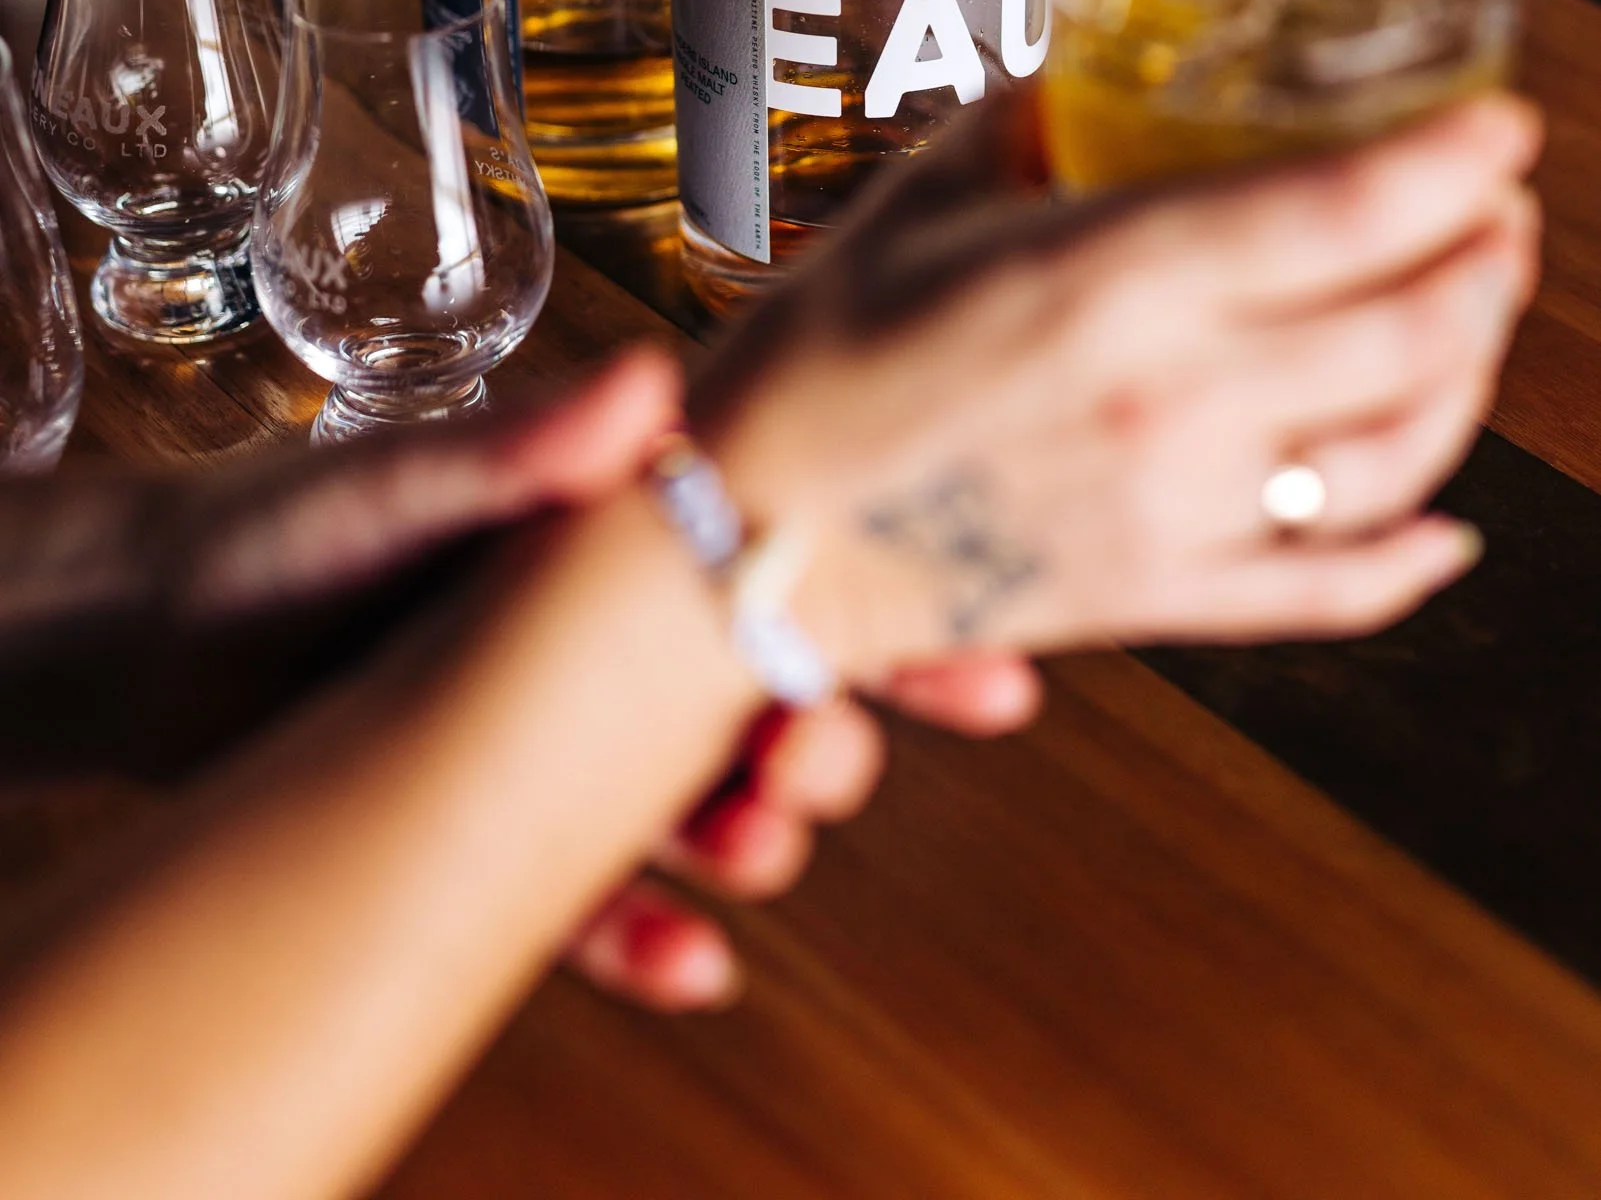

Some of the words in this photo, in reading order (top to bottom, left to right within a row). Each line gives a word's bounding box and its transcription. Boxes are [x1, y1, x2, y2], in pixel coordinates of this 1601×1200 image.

[697, 53, 738, 86] ISLAND
[697, 70, 726, 96] MALT
[120, 141, 168, 159] LTD
